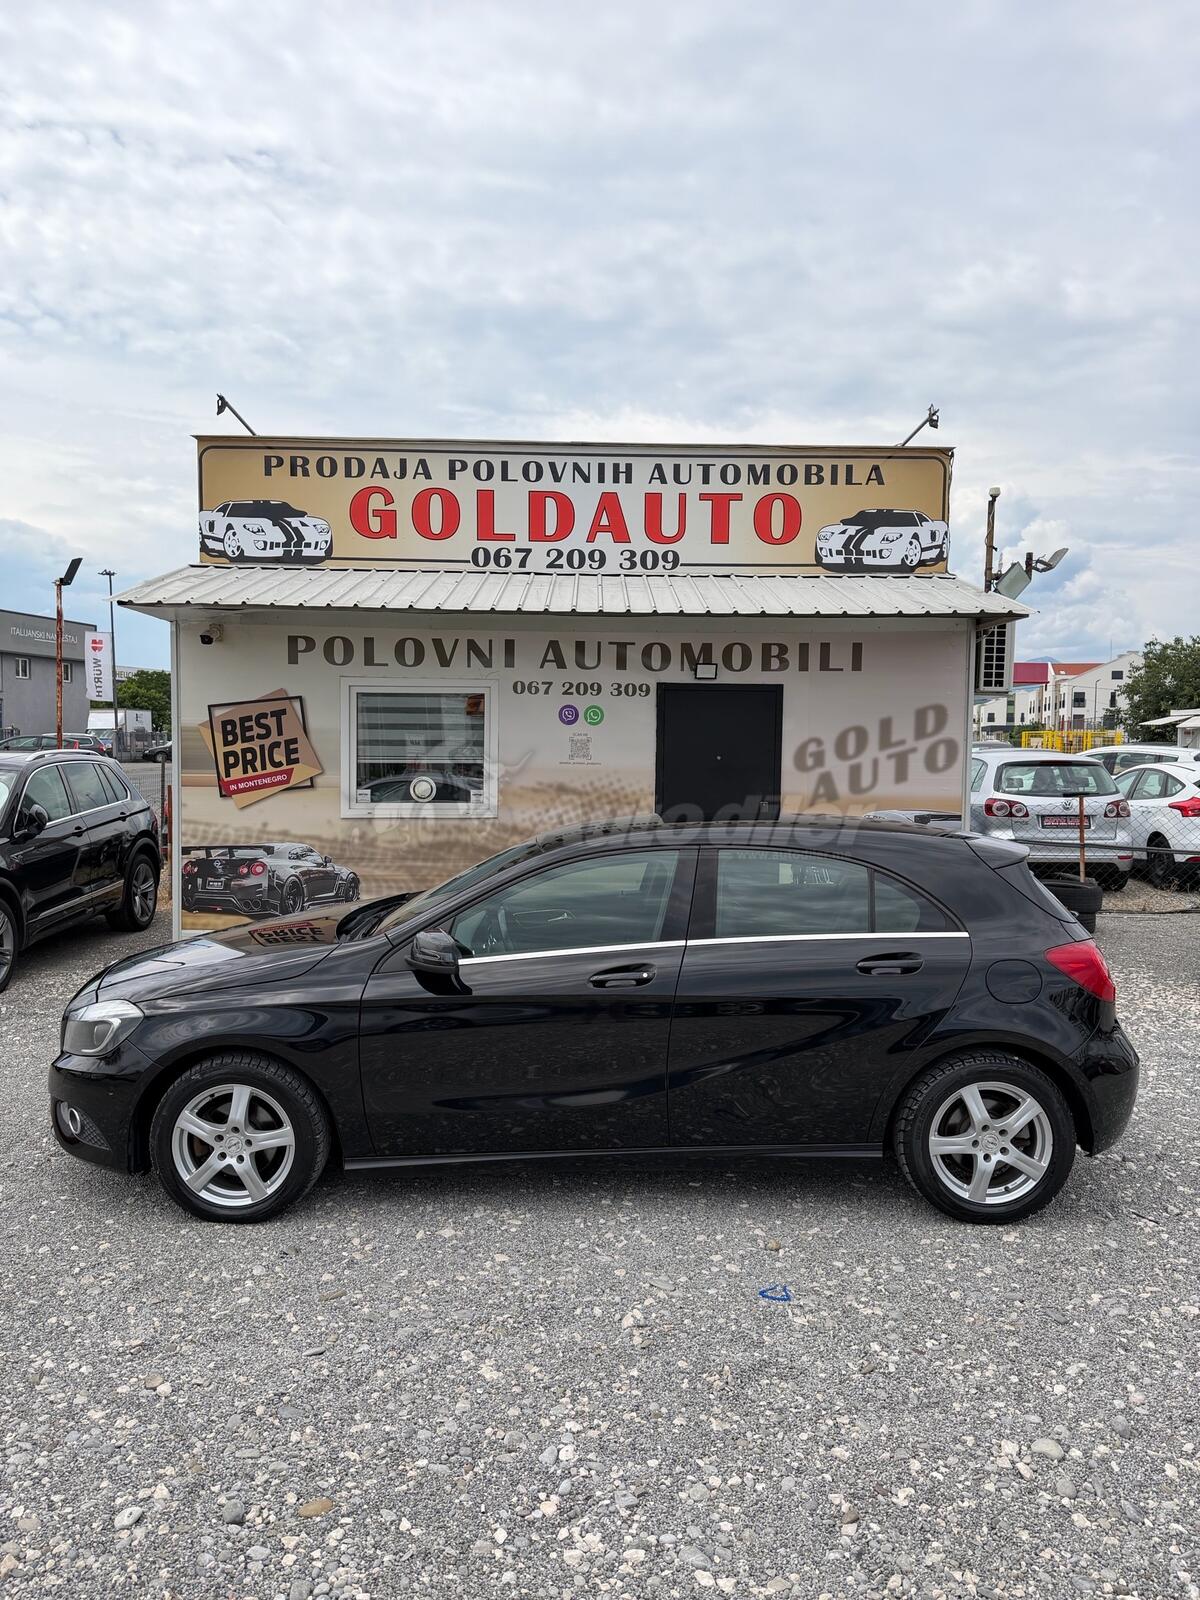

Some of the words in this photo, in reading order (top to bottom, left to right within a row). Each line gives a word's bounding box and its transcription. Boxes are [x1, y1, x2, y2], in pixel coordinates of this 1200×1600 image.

[263, 455, 433, 480] PRODAJA
[448, 459, 633, 484] POLOVNIH
[648, 463, 885, 486] AUTOMOBILA
[349, 485, 803, 546] GOLDAUTO
[470, 547, 532, 569] 067
[545, 548, 607, 570] 209
[619, 549, 681, 571] 309
[287, 635, 516, 668] POLOVNI
[539, 639, 864, 672] AUTOMOBILI
[512, 680, 554, 696] 067
[562, 681, 603, 697] 209
[609, 682, 651, 698] 309
[221, 708, 287, 747] BEST
[793, 703, 949, 774] GOLD
[223, 737, 300, 779] PRICE
[808, 736, 960, 808] AUTO
[238, 774, 288, 790] MONTENEGRO
